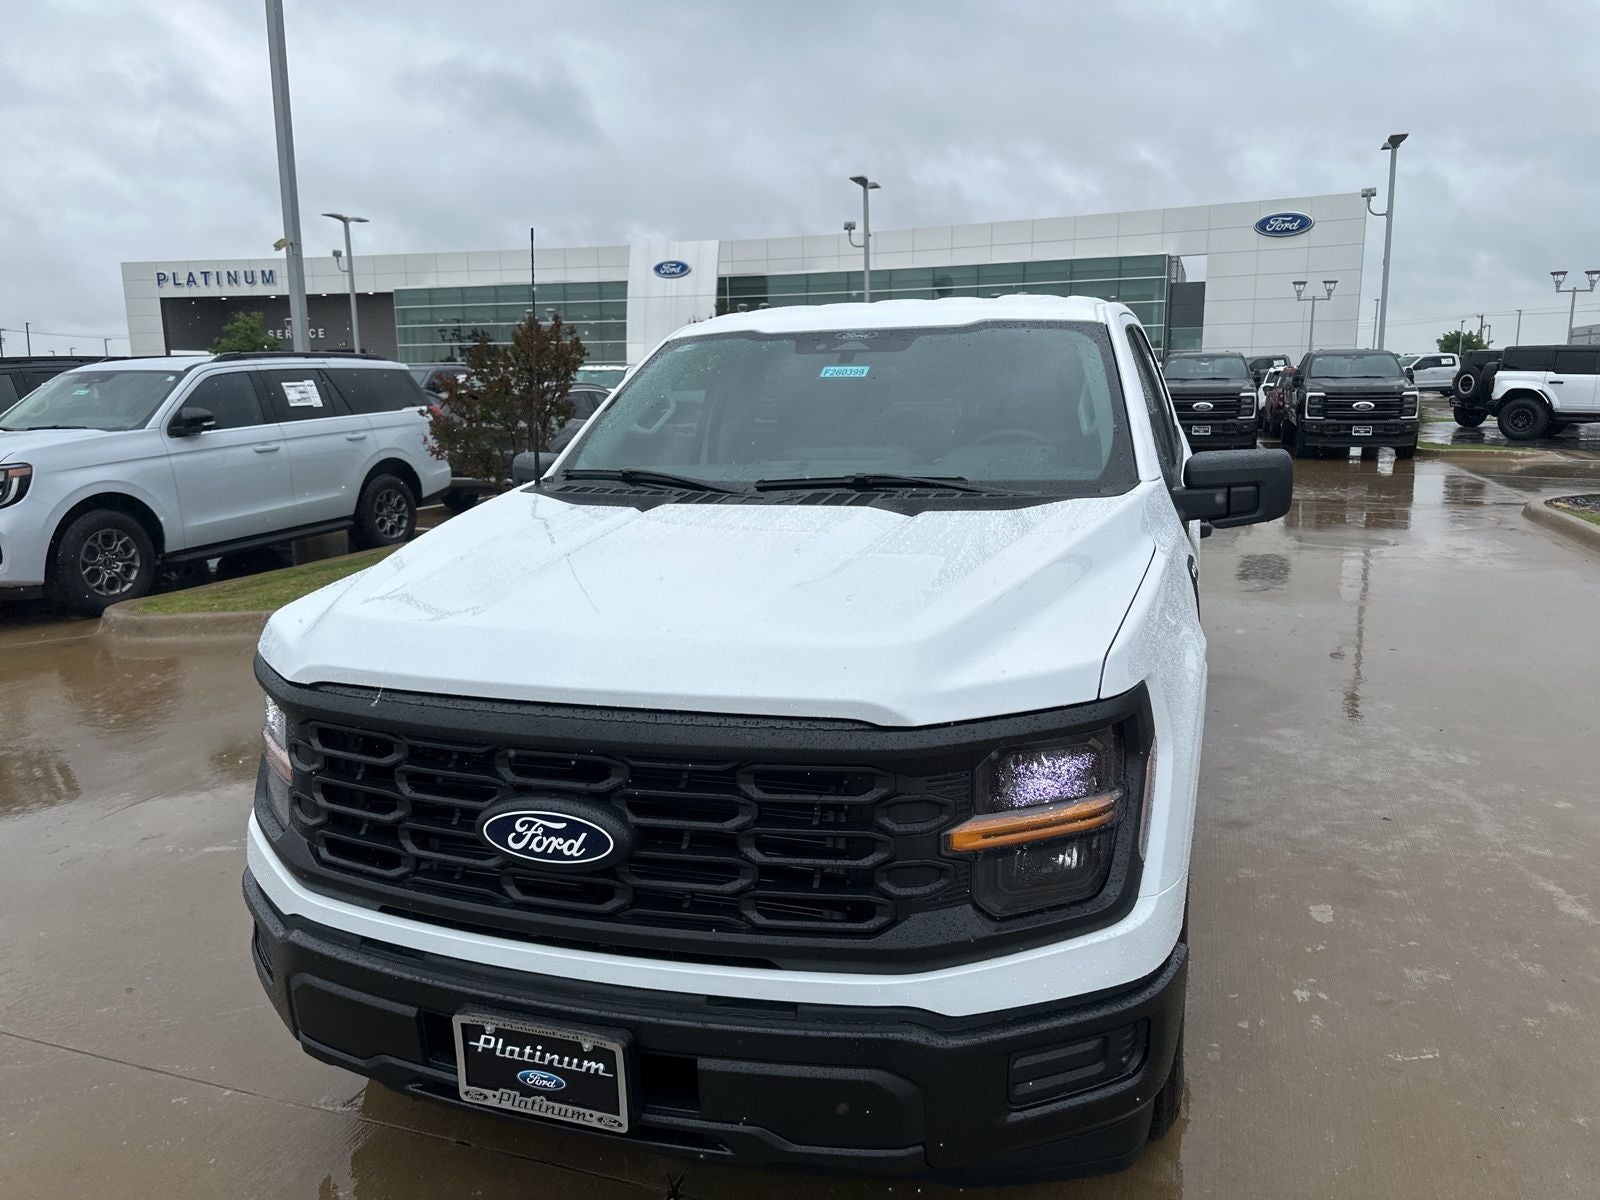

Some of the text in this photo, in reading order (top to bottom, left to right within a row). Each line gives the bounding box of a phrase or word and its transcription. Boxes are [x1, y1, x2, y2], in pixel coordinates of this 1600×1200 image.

[1266, 217, 1301, 231] Ford
[660, 263, 682, 274] Ford
[156, 269, 277, 288] PLATINUM
[267, 328, 326, 340] SERCE
[823, 368, 866, 376] F260399
[507, 816, 588, 857] Ford
[468, 1034, 614, 1077] Platinum
[526, 1072, 557, 1089] Ford
